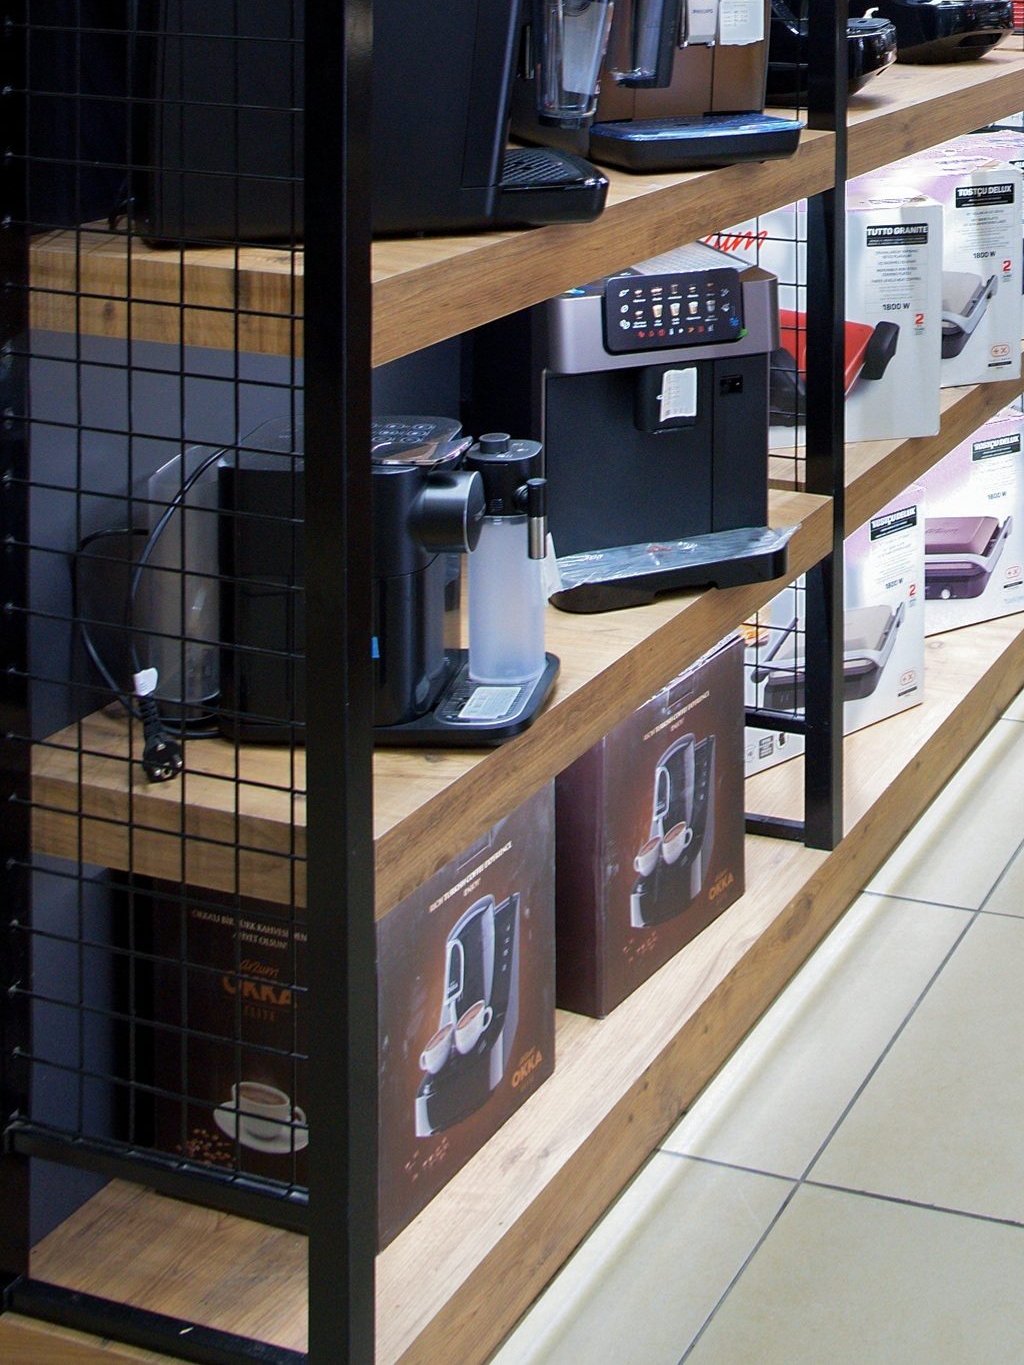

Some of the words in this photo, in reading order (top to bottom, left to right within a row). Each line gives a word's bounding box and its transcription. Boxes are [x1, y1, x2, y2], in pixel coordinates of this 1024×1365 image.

[956, 186, 987, 198] TOSTÇU
[987, 184, 1013, 195] DELUX
[866, 227, 893, 237] TUTTO
[893, 225, 928, 236] GRANITE
[1002, 260, 1012, 272] 2
[882, 302, 902, 311] 1800
[903, 302, 911, 310] W
[915, 314, 925, 325] 2
[909, 585, 916, 597] 2
[511, 1049, 543, 1088] OKKA
